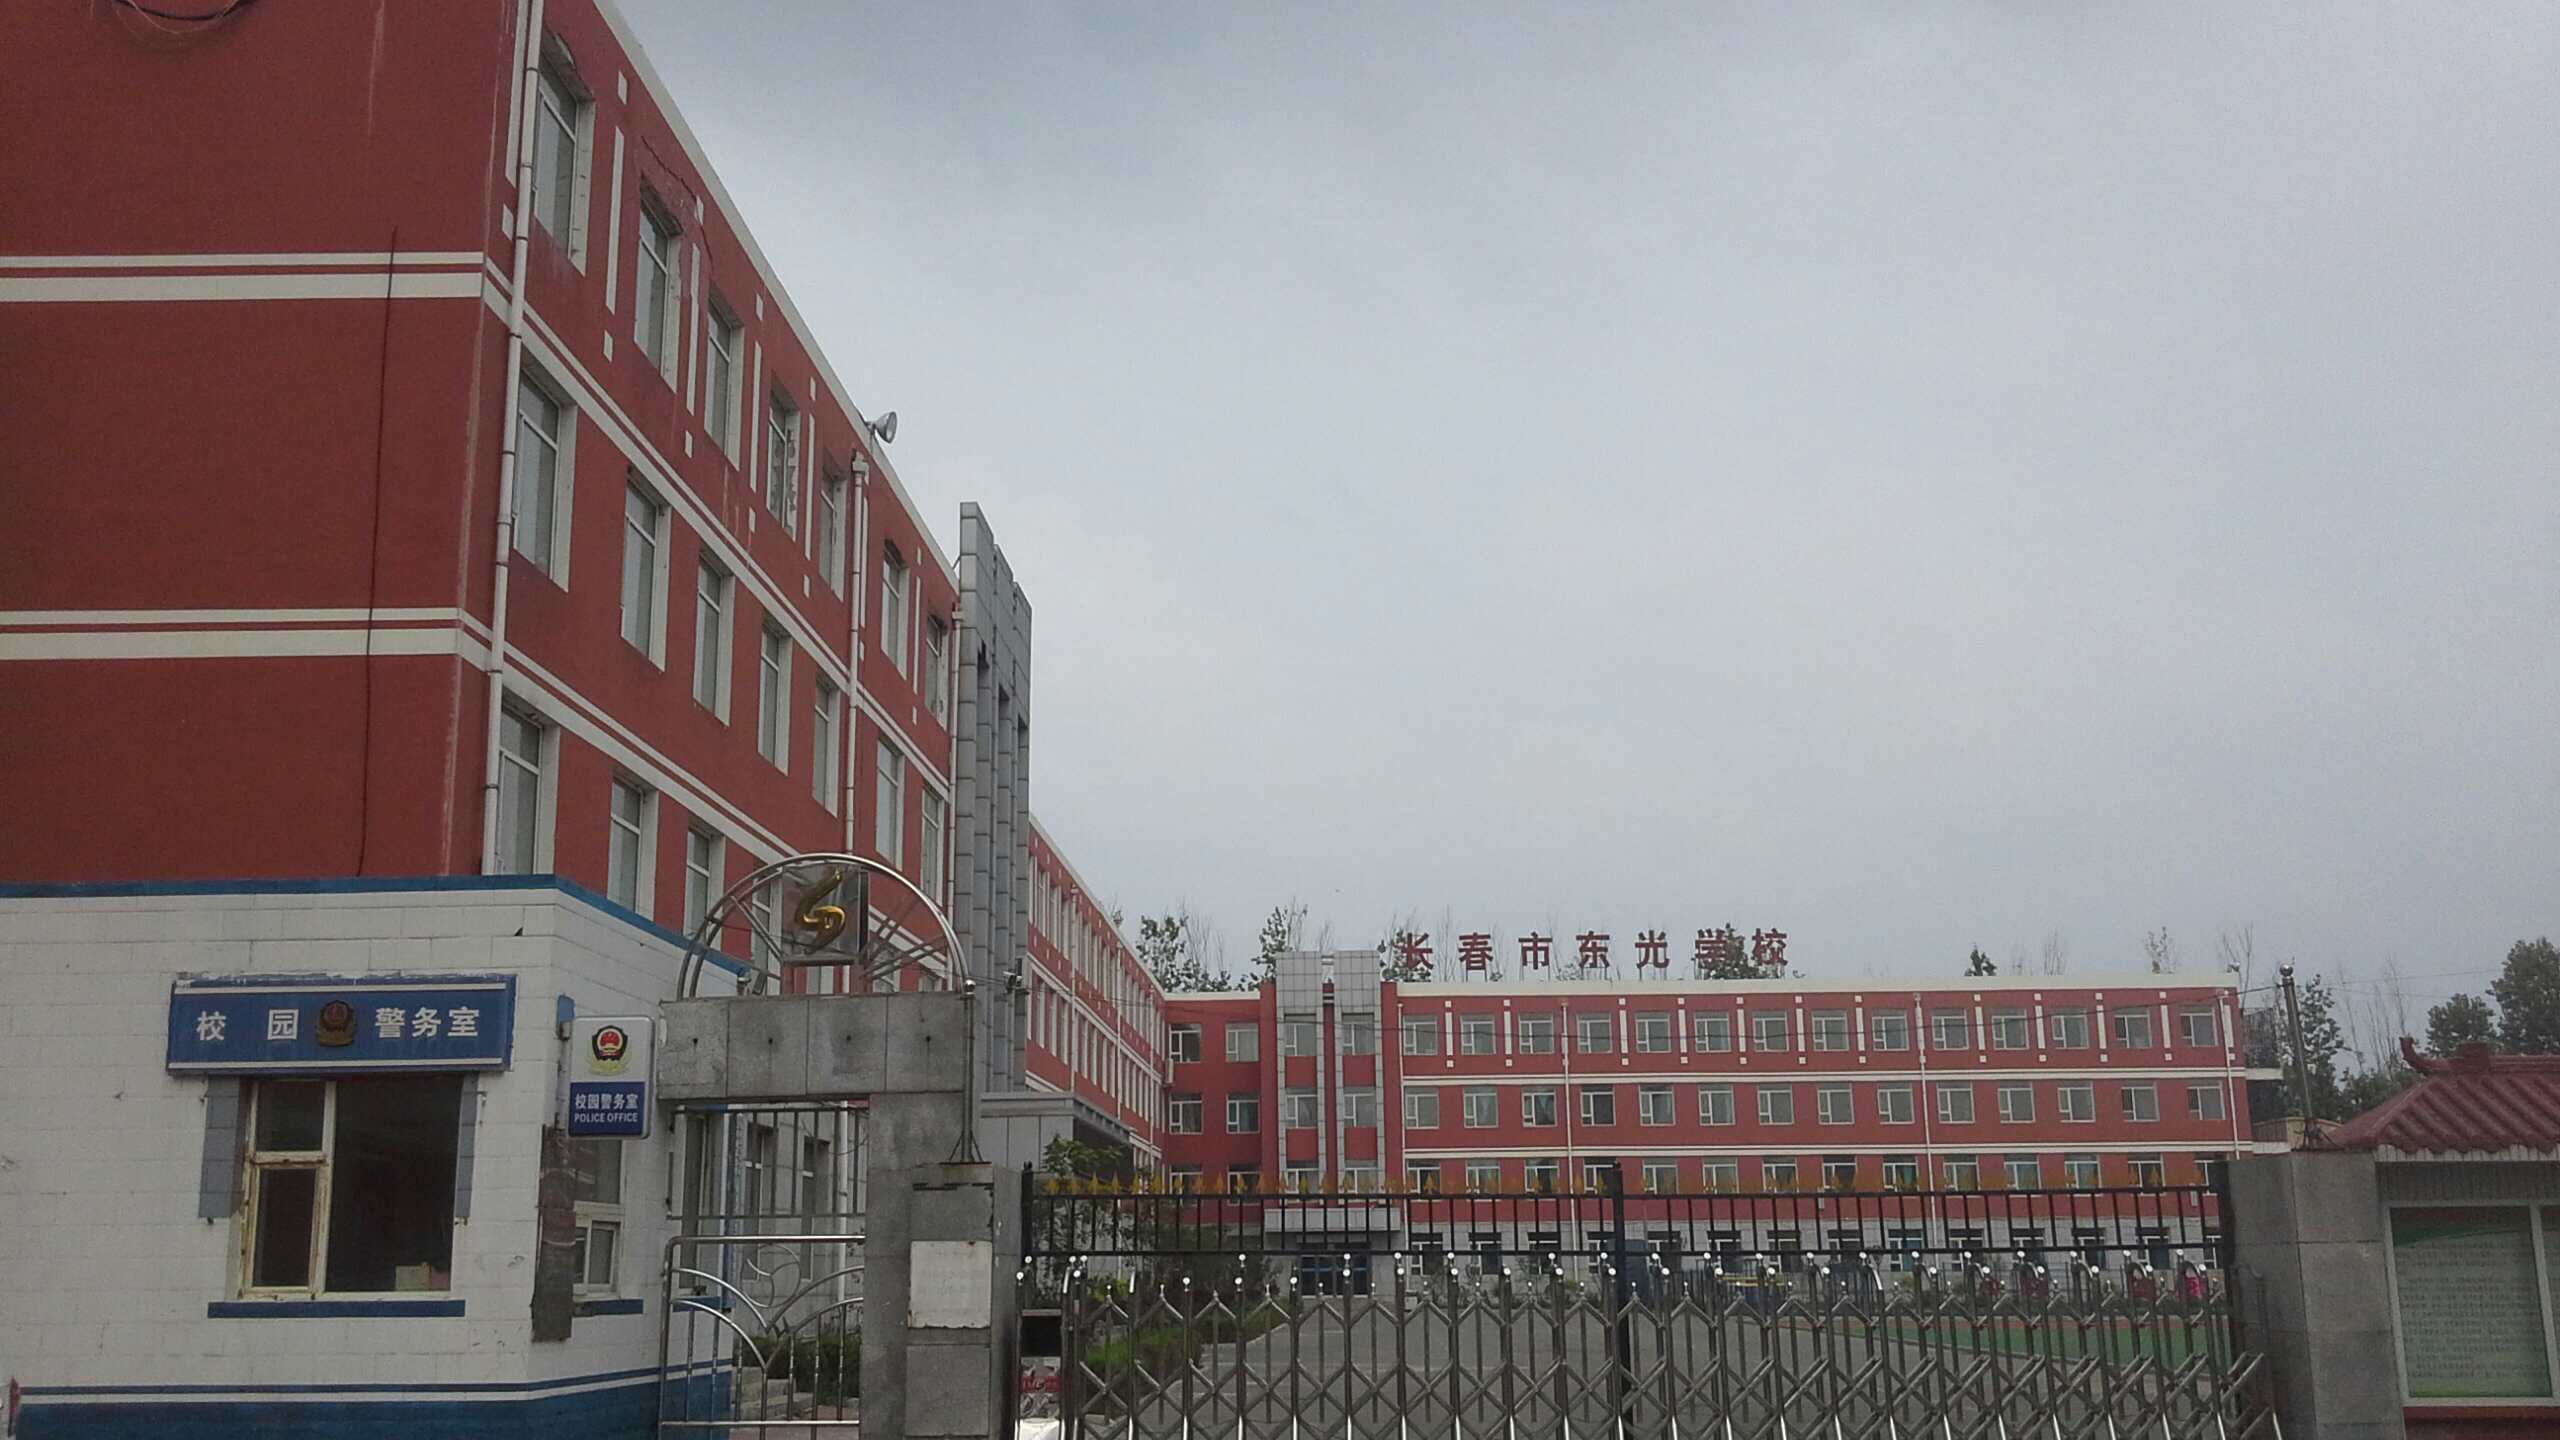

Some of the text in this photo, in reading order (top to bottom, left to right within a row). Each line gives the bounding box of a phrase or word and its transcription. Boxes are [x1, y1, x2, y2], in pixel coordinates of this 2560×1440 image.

[1400, 927, 1789, 971] 长春市东光学校
[197, 1007, 480, 1041] 校园 警务室
[575, 1093, 638, 1109] 校园警务室
[574, 1112, 638, 1123] POLICE OFFICE
